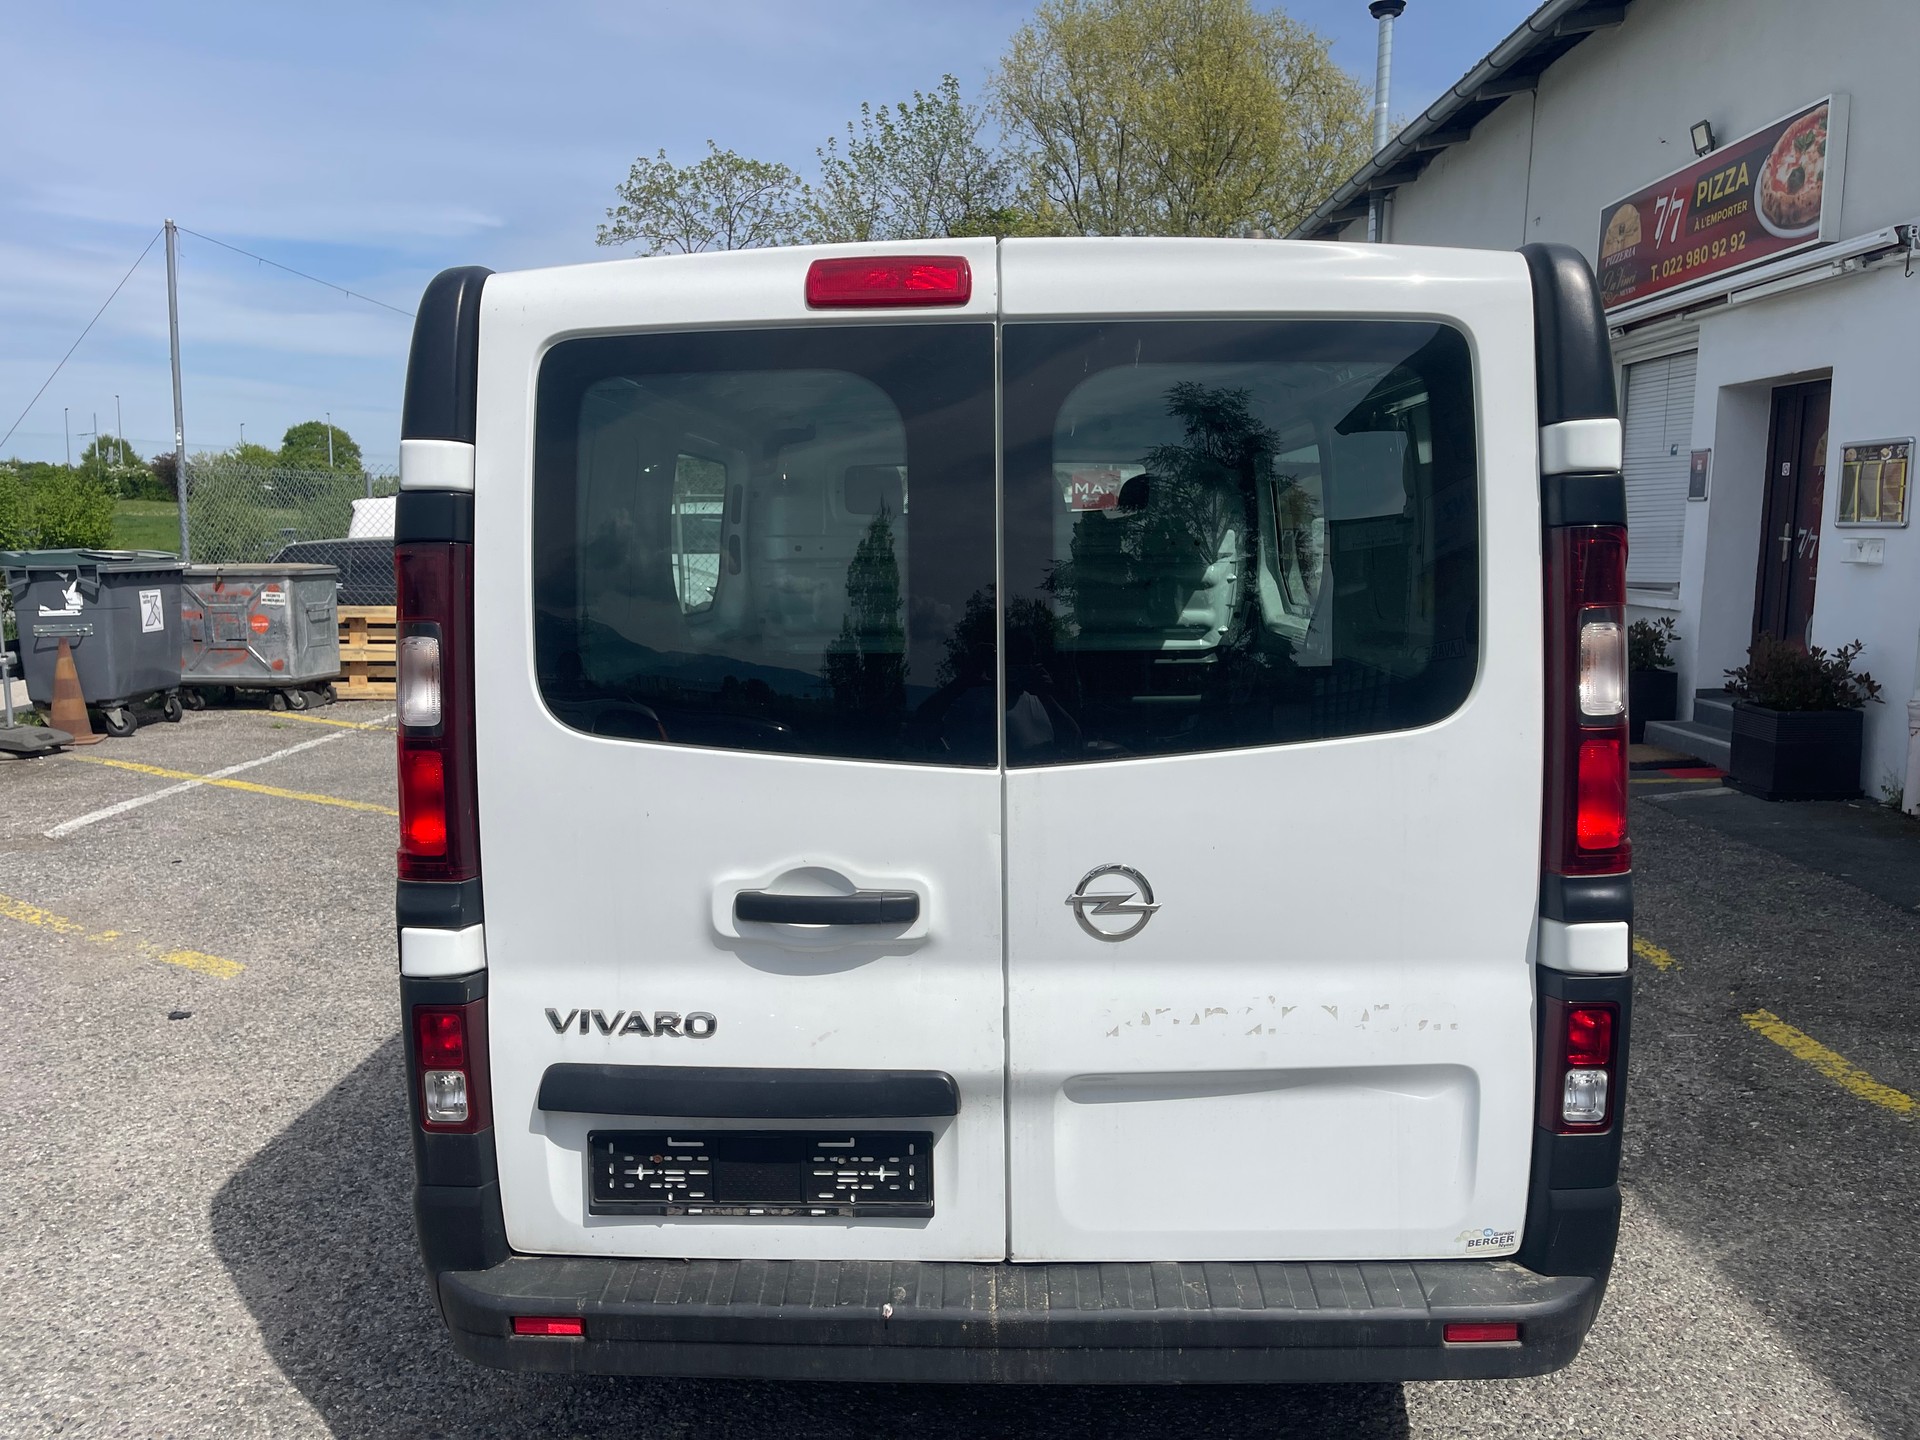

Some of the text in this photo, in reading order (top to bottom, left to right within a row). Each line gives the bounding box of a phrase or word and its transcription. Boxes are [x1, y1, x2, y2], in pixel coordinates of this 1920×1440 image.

[1696, 161, 1749, 208] PIZZA
[1654, 187, 1684, 250] 7/7
[1694, 200, 1748, 232] À L'EMPORTER
[1605, 246, 1637, 268] PIZZERIA
[1650, 230, 1746, 282] T. 022 980 92 92
[1797, 526, 1819, 559] 7/7
[544, 1007, 718, 1040] VIVARO
[1468, 1235, 1514, 1247] BERGER
